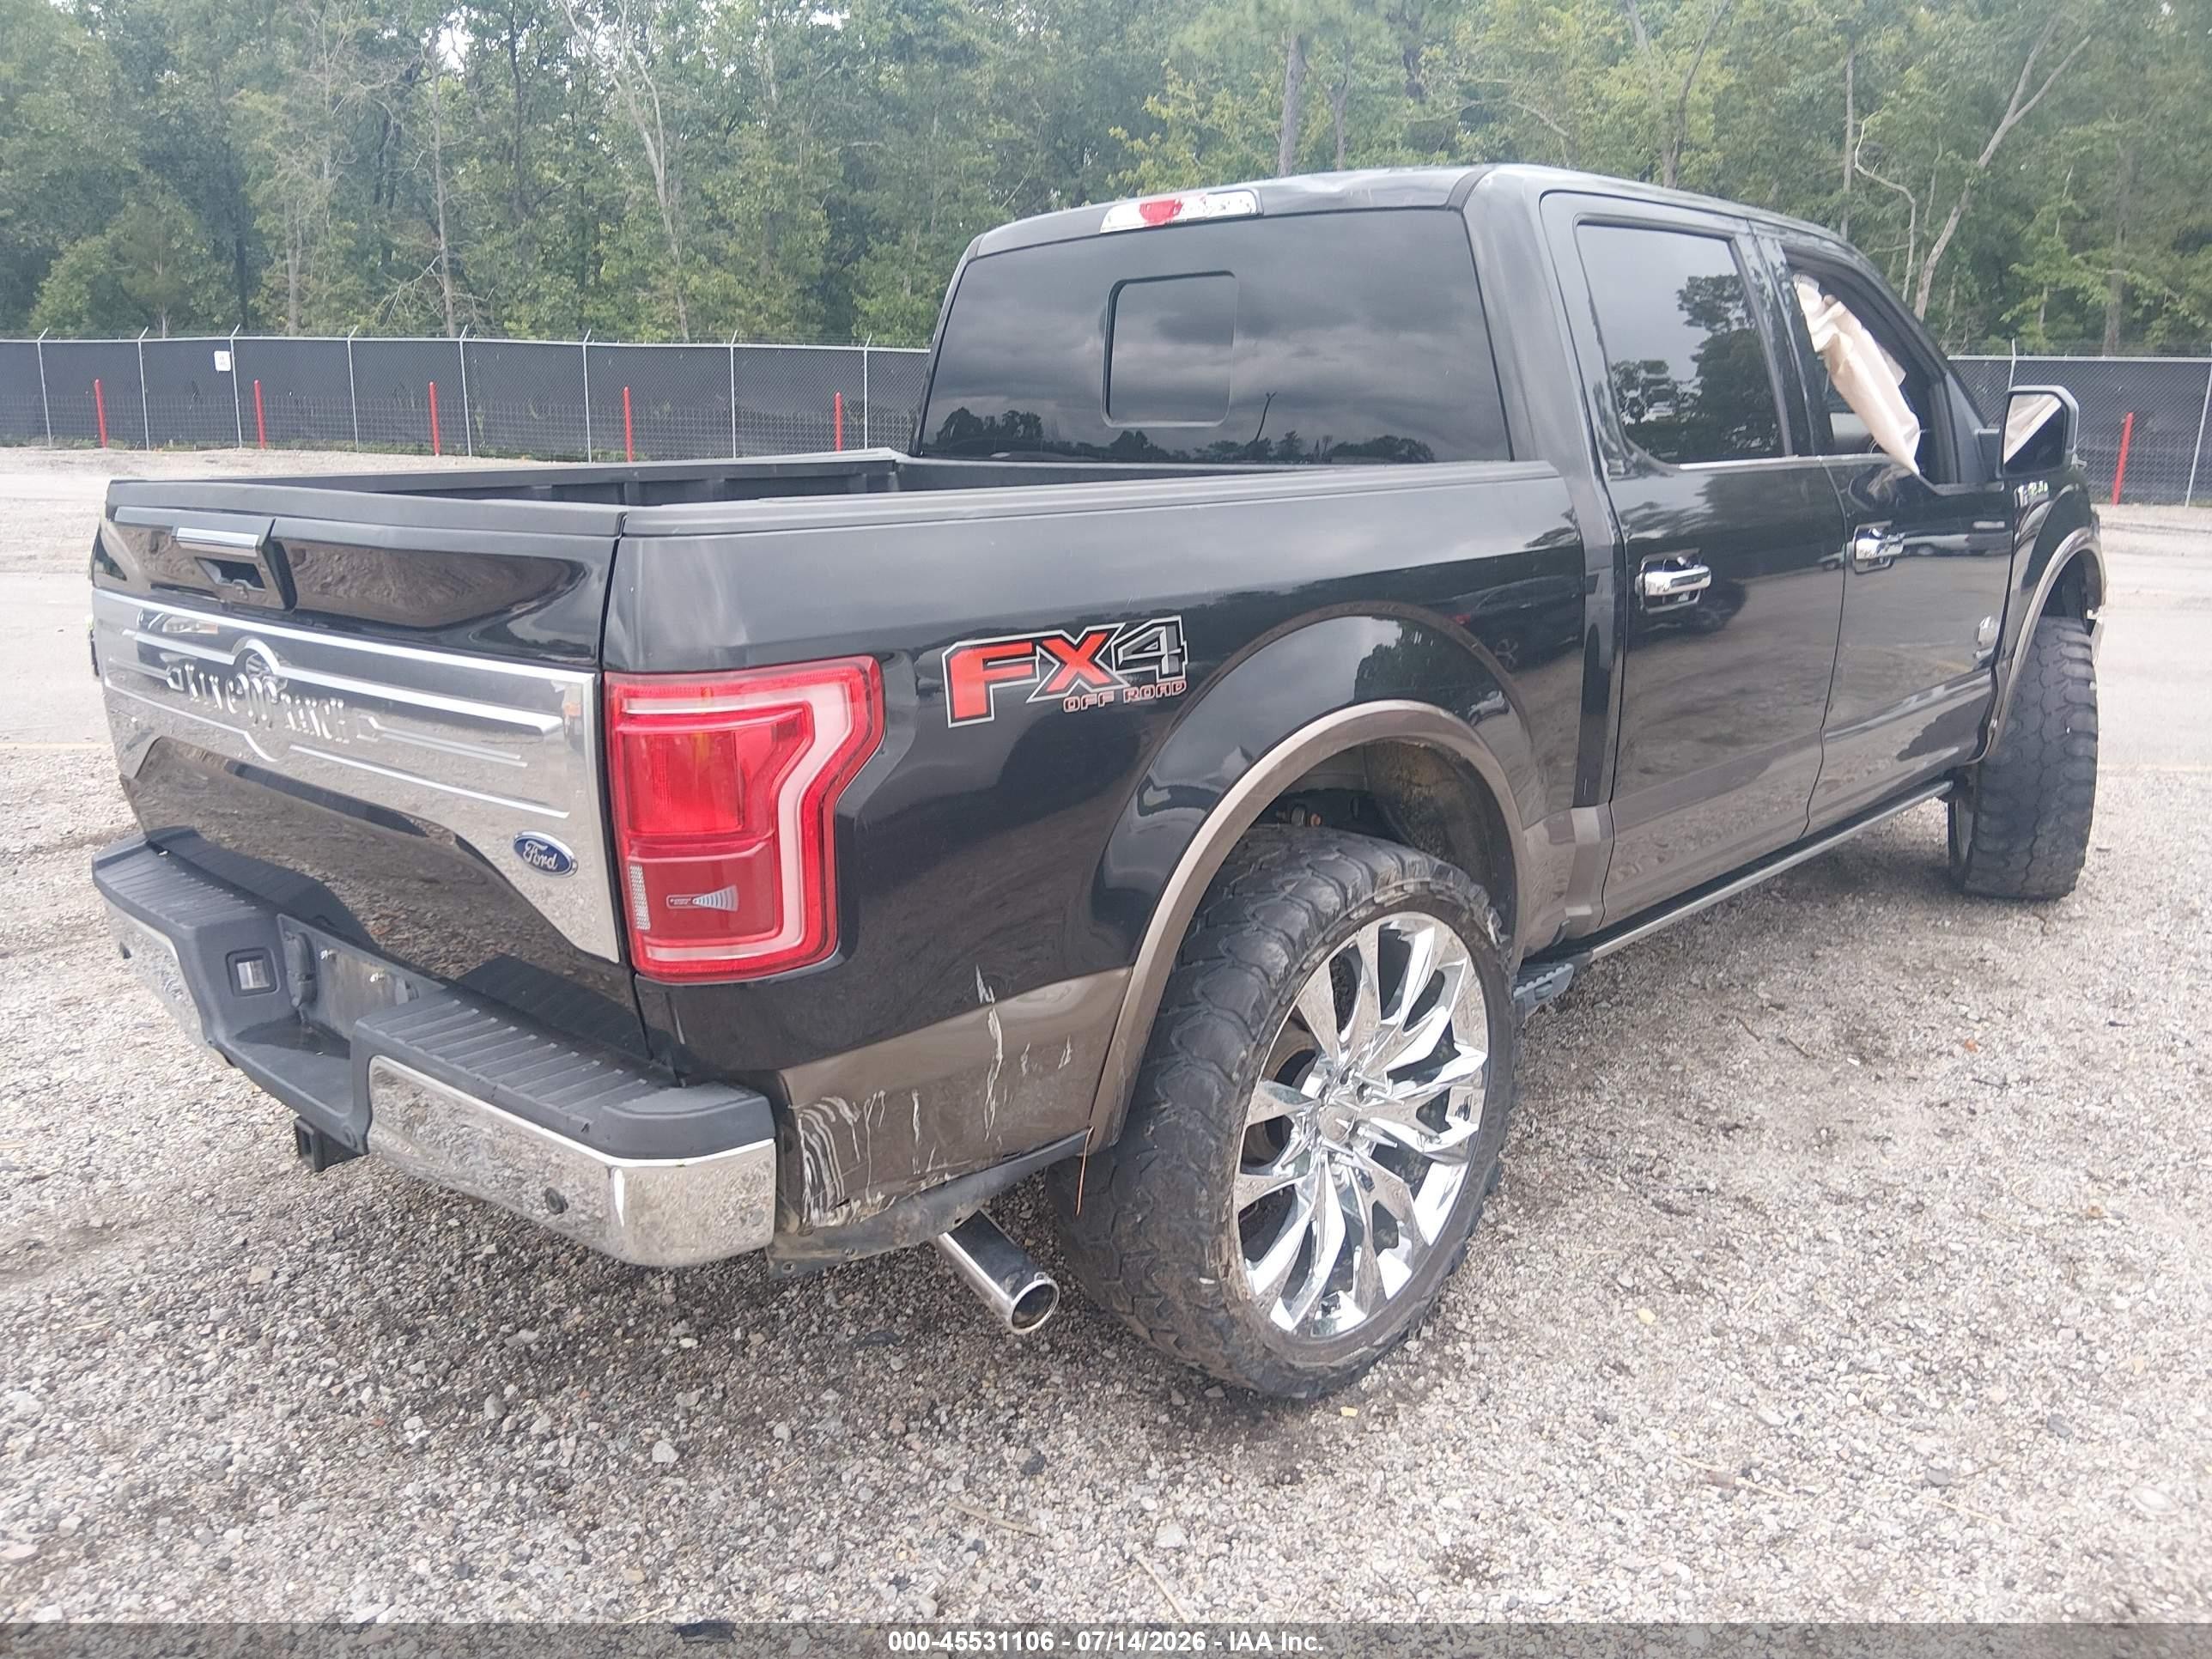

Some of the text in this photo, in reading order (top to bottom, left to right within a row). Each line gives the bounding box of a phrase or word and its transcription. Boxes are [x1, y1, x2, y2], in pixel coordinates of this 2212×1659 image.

[942, 615, 1188, 728] FX4
[1063, 680, 1188, 713] OFF ROAD
[523, 840, 558, 870] Ford
